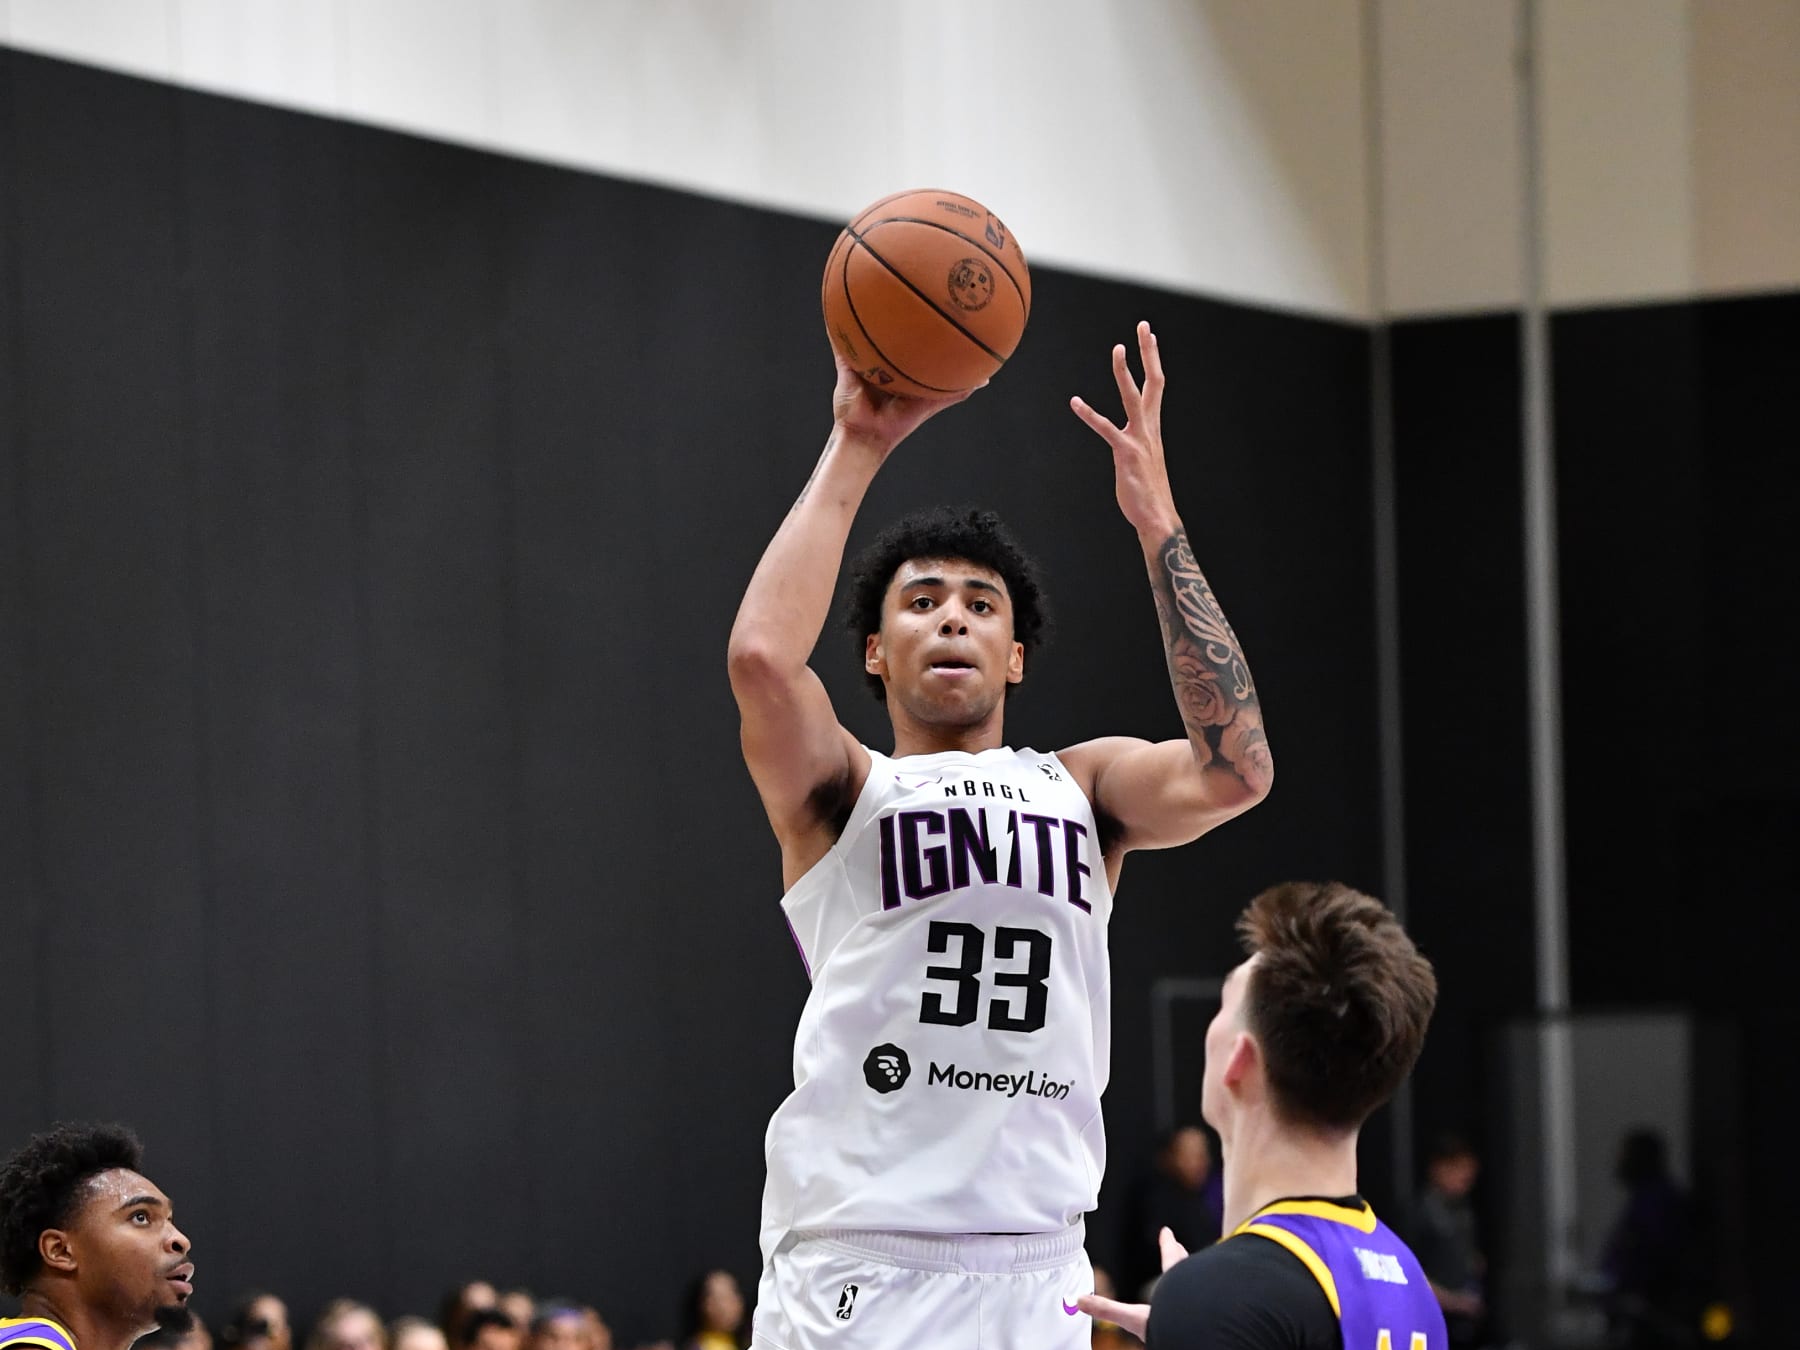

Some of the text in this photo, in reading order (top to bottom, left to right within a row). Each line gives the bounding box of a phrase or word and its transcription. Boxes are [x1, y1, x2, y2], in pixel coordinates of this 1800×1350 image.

[944, 780, 1030, 803] NBAGL
[879, 807, 1092, 915] IGNITE
[919, 920, 1053, 1033] 33
[928, 1061, 1072, 1101] MoneyLion
